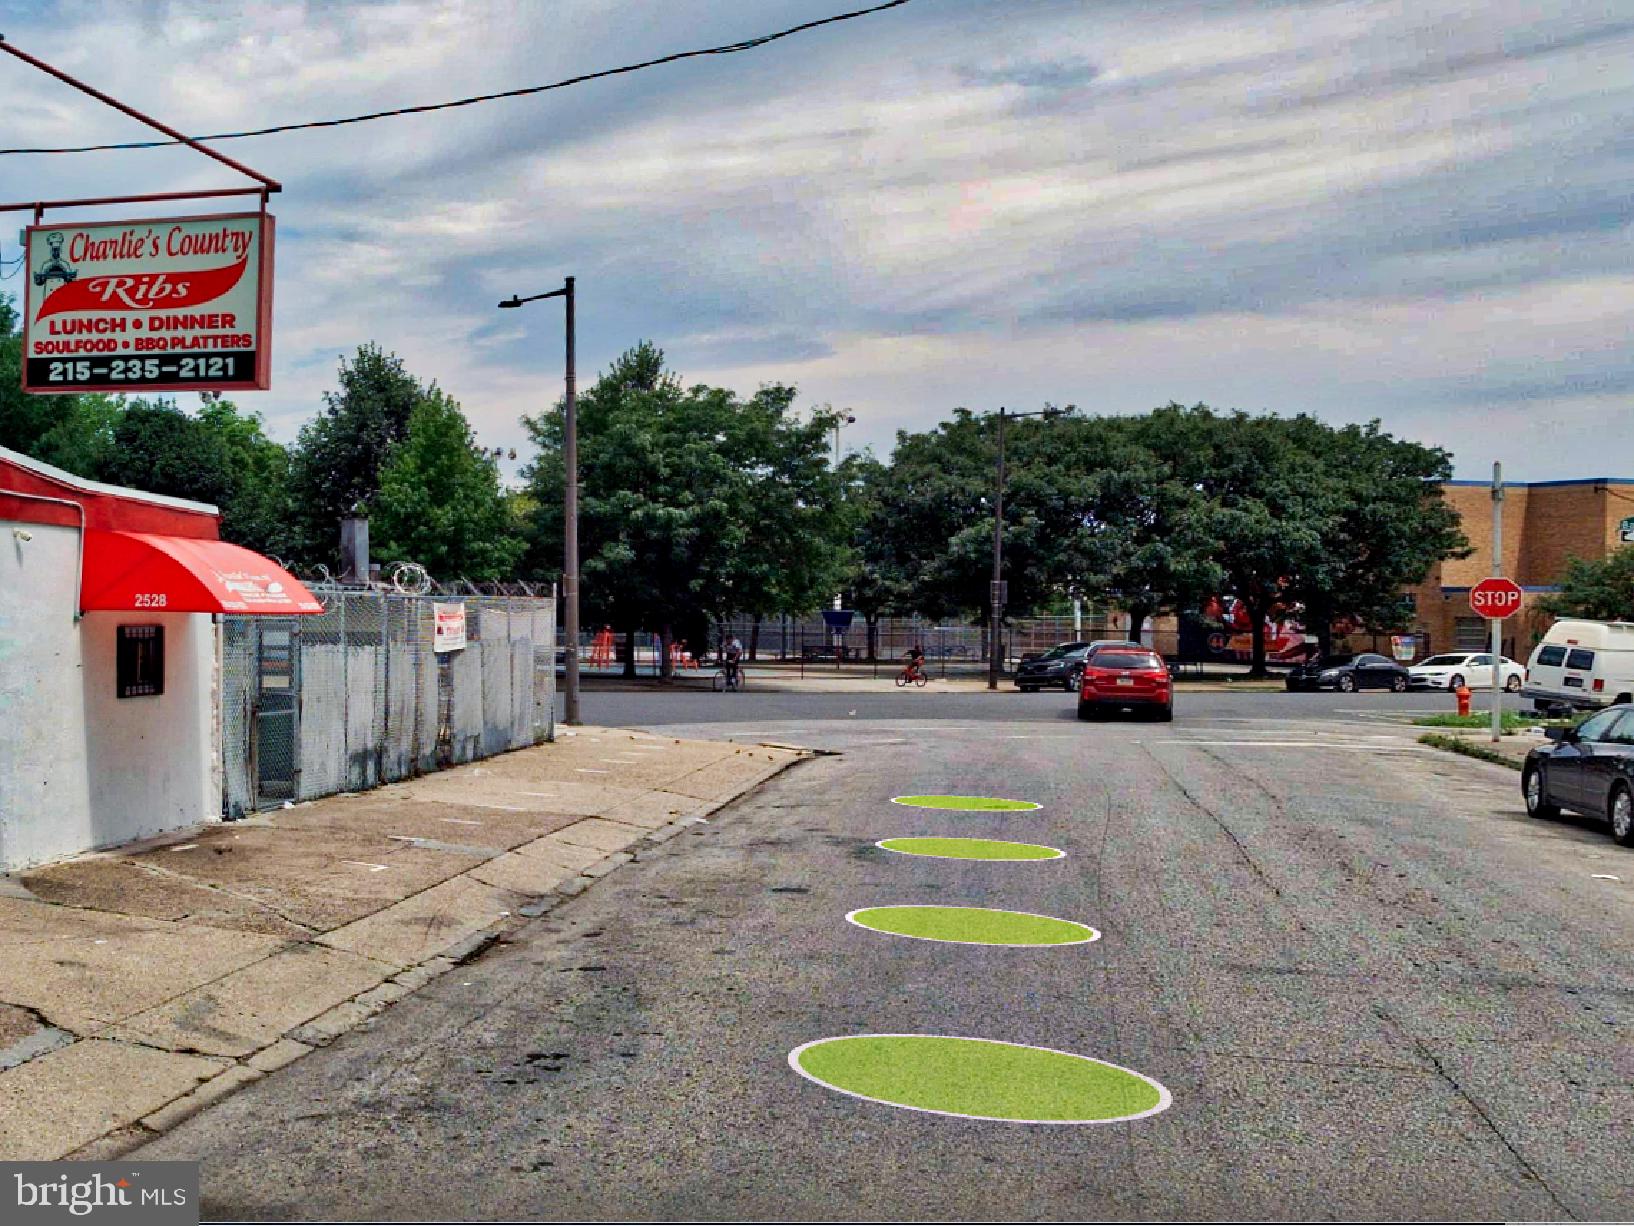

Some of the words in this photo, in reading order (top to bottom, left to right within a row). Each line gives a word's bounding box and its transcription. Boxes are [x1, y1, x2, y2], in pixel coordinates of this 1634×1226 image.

[69, 228, 160, 263] Charlie's
[167, 225, 253, 259] Country
[88, 274, 191, 309] Ribs
[49, 317, 127, 336] LUNCH
[149, 313, 236, 332] DINNER
[33, 338, 118, 355] SOULFOOD
[134, 336, 169, 351] BBQ
[170, 333, 252, 350] PLATTERS
[49, 356, 235, 382] 215-235-2121
[134, 593, 167, 607] 2528
[1474, 591, 1519, 606] STOP
